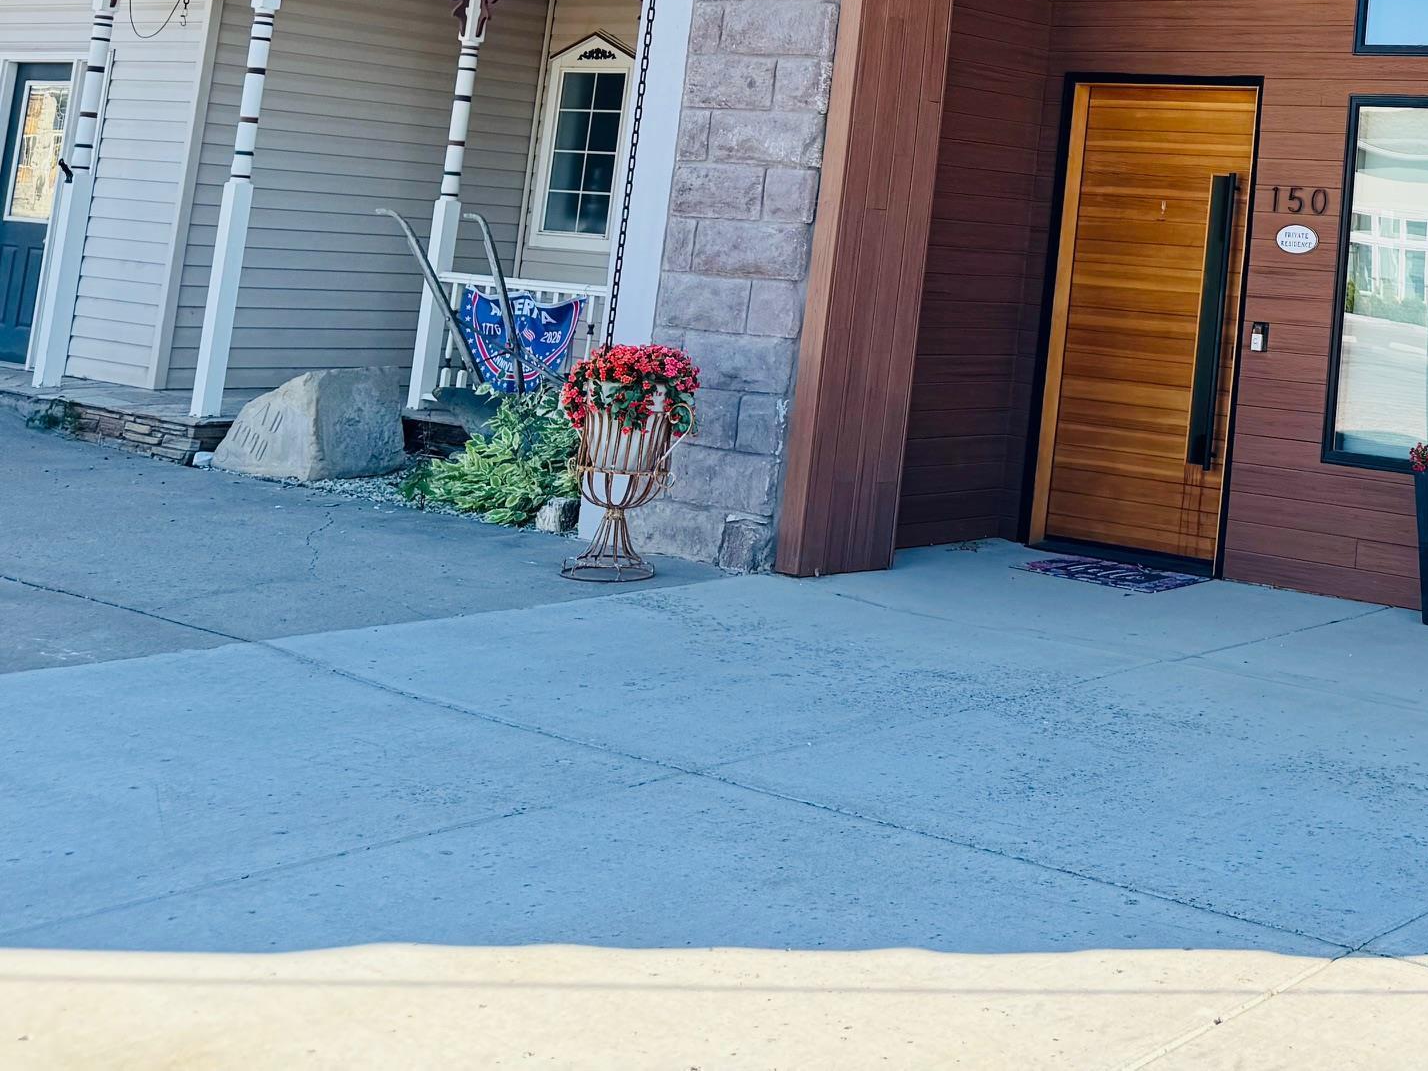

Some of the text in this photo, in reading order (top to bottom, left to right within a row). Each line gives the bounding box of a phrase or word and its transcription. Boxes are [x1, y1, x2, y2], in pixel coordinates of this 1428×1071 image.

[1272, 186, 1328, 215] 150
[1284, 231, 1309, 240] PRIVATE
[1280, 240, 1313, 249] RESIDENCE
[490, 298, 557, 324] AERIA
[481, 322, 502, 336] 1776
[540, 330, 562, 344] 2026
